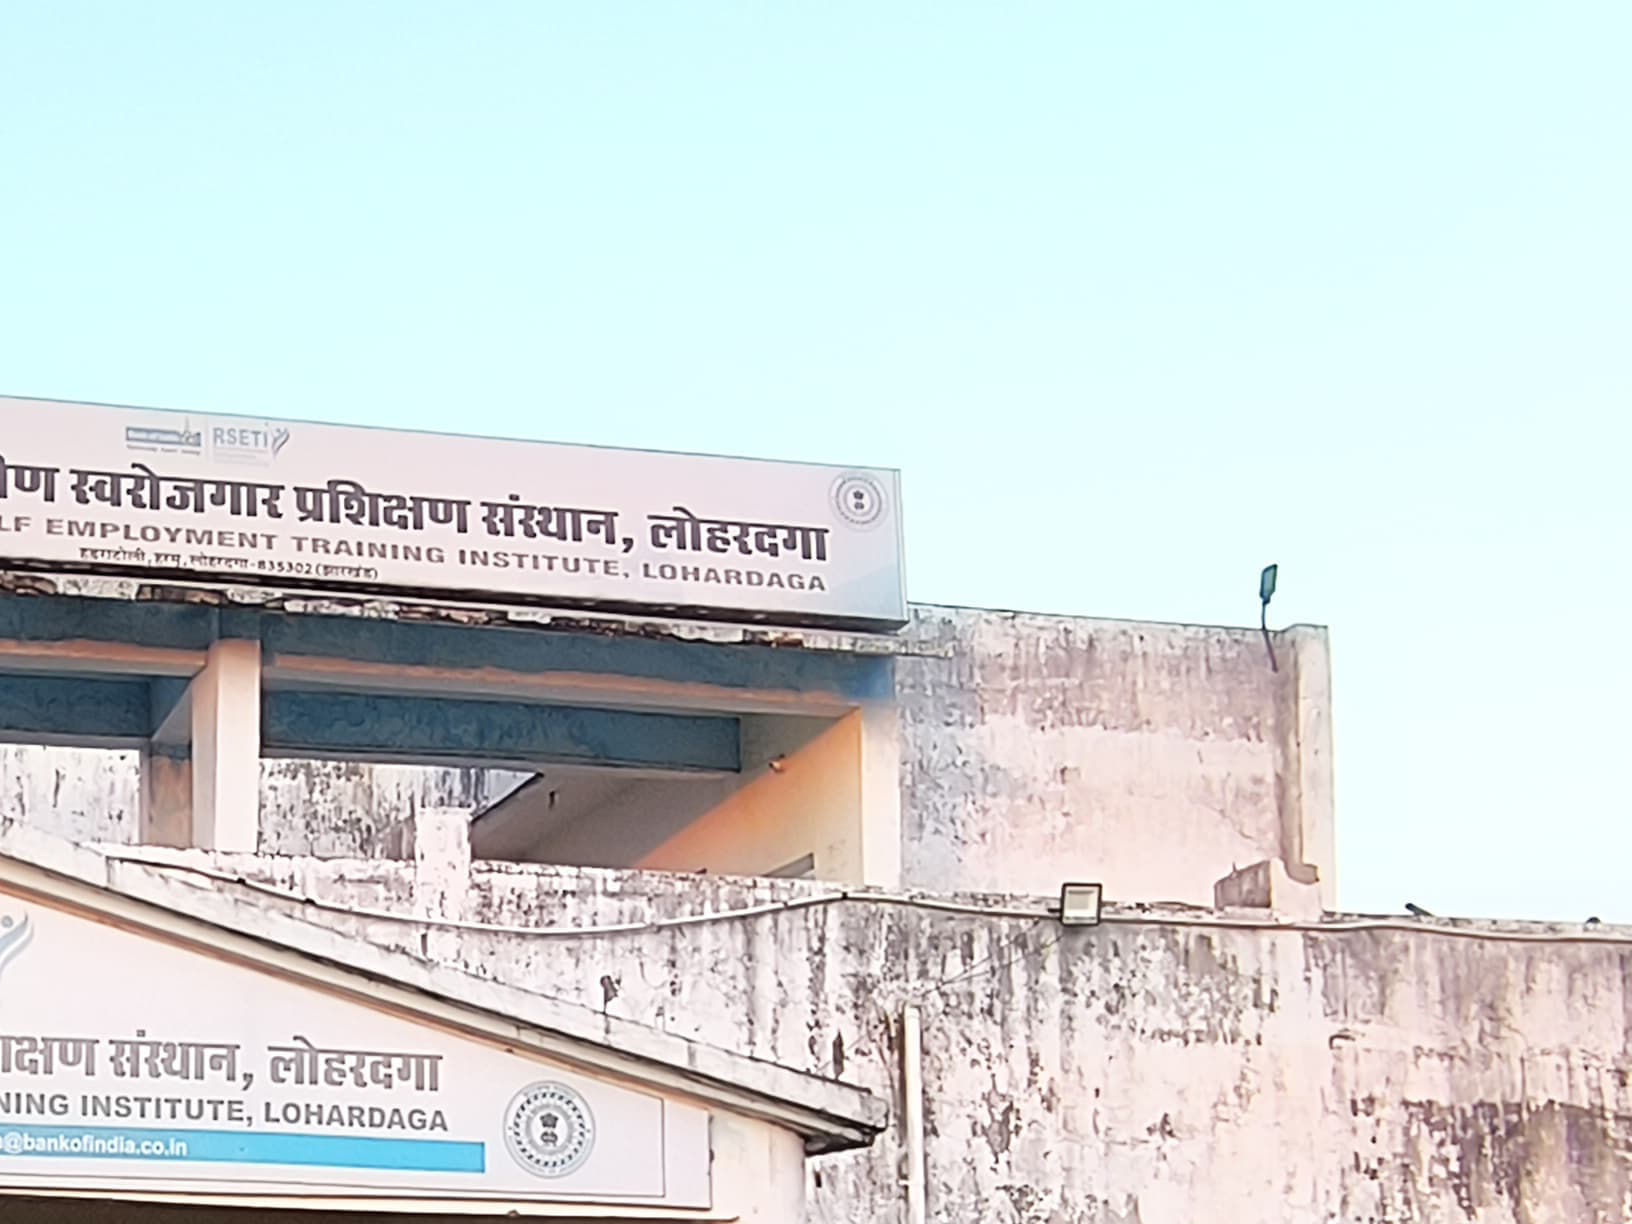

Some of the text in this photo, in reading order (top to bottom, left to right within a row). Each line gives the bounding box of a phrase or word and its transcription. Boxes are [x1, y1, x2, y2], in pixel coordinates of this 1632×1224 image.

[70, 464, 283, 519] स्वरोजगार
[293, 480, 471, 533] प्रशिक्षण
[481, 492, 634, 551] संस्थान,
[647, 506, 829, 563] लोहरदगा
[45, 516, 278, 550] EMPLOYMENT
[292, 535, 444, 565] TRAINING
[458, 548, 629, 578] INSTITUTE,
[643, 562, 827, 592] LOHARDAGA
[109, 1030, 254, 1091] संस्थान,
[269, 1036, 443, 1092] लोहरदगा
[80, 1095, 253, 1126] INSTITUTE,
[264, 1101, 448, 1132] LOHARDAGA
